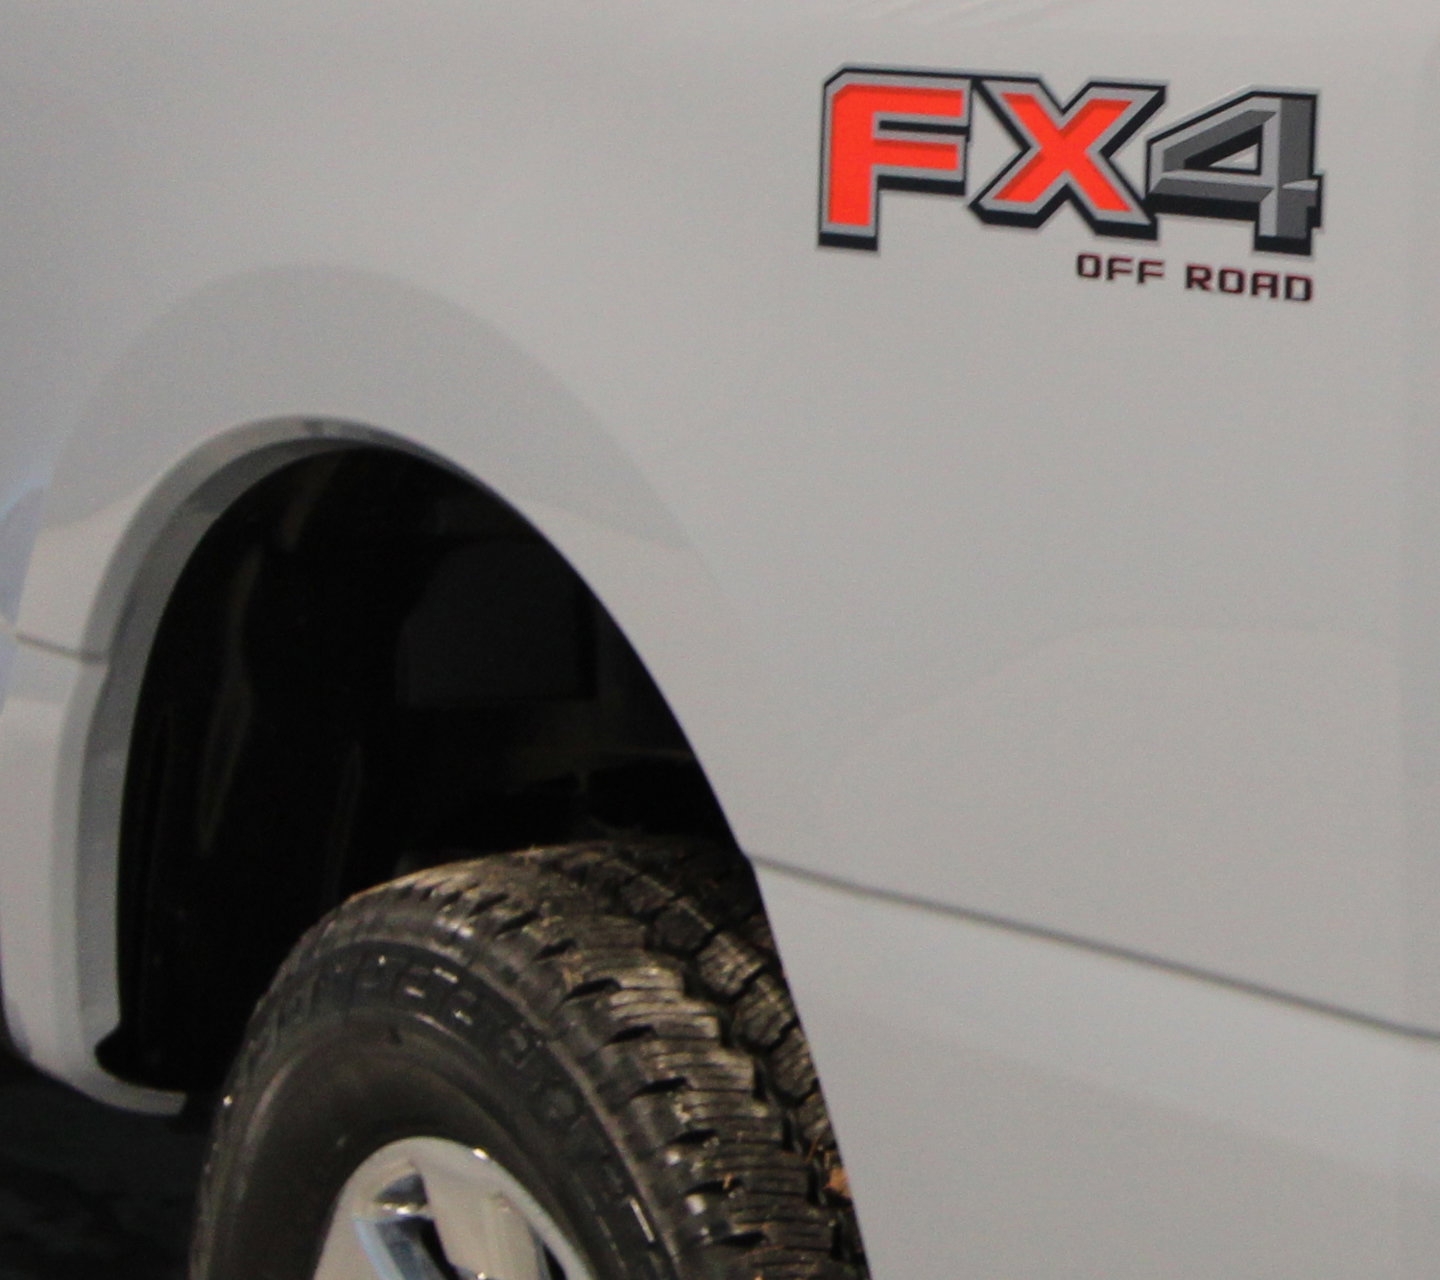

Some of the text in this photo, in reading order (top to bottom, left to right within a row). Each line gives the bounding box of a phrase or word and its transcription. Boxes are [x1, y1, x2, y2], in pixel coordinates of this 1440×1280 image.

[817, 66, 1323, 256] FX4
[1075, 252, 1314, 303] OFF ROAD
